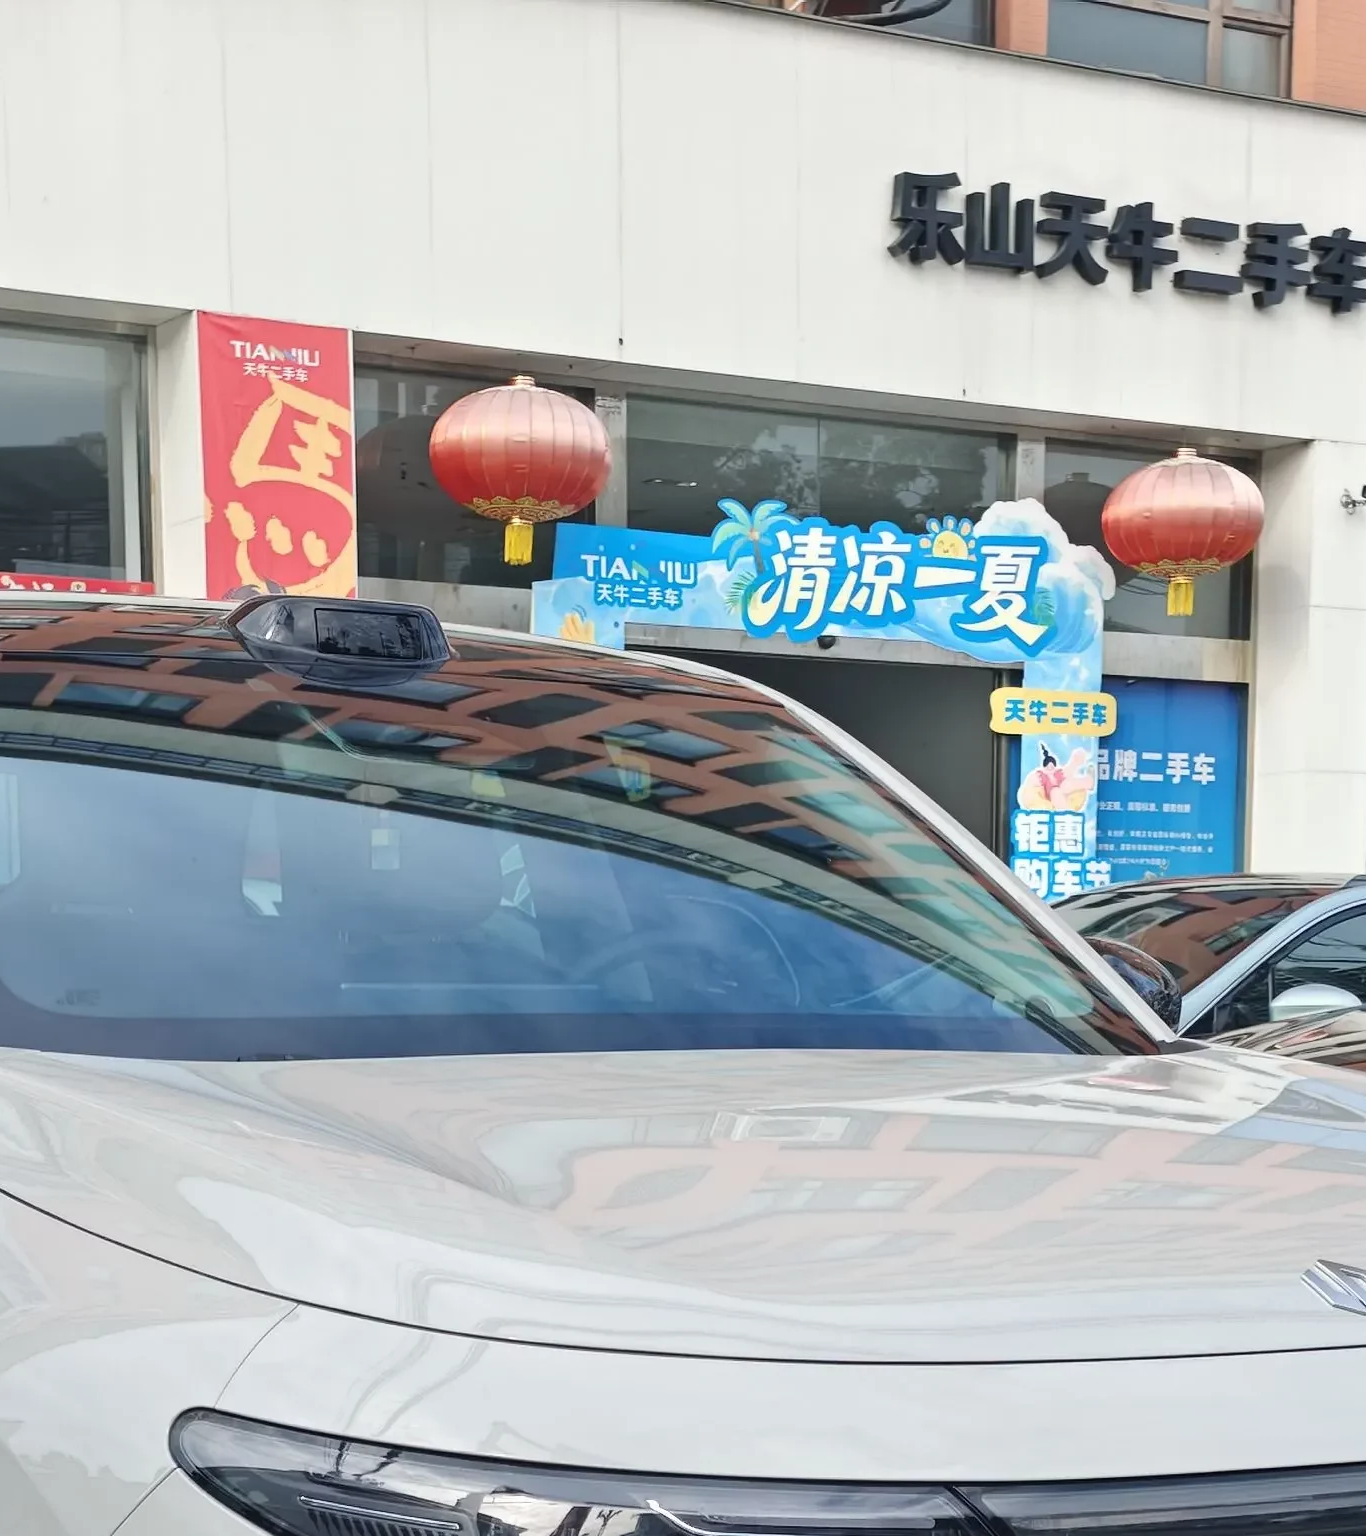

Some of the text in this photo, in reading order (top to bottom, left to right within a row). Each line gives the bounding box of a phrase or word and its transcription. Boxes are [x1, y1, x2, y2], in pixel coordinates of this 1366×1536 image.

[242, 362, 309, 383] 天牛二手车
[596, 582, 682, 609] 天牛二手车
[747, 525, 1048, 644] 清凉一夏
[1004, 698, 1109, 727] 天牛二手车
[1097, 748, 1216, 786] 品牌二手车
[1014, 811, 1085, 855] 钜惠
[1014, 857, 1112, 900] 购车节
